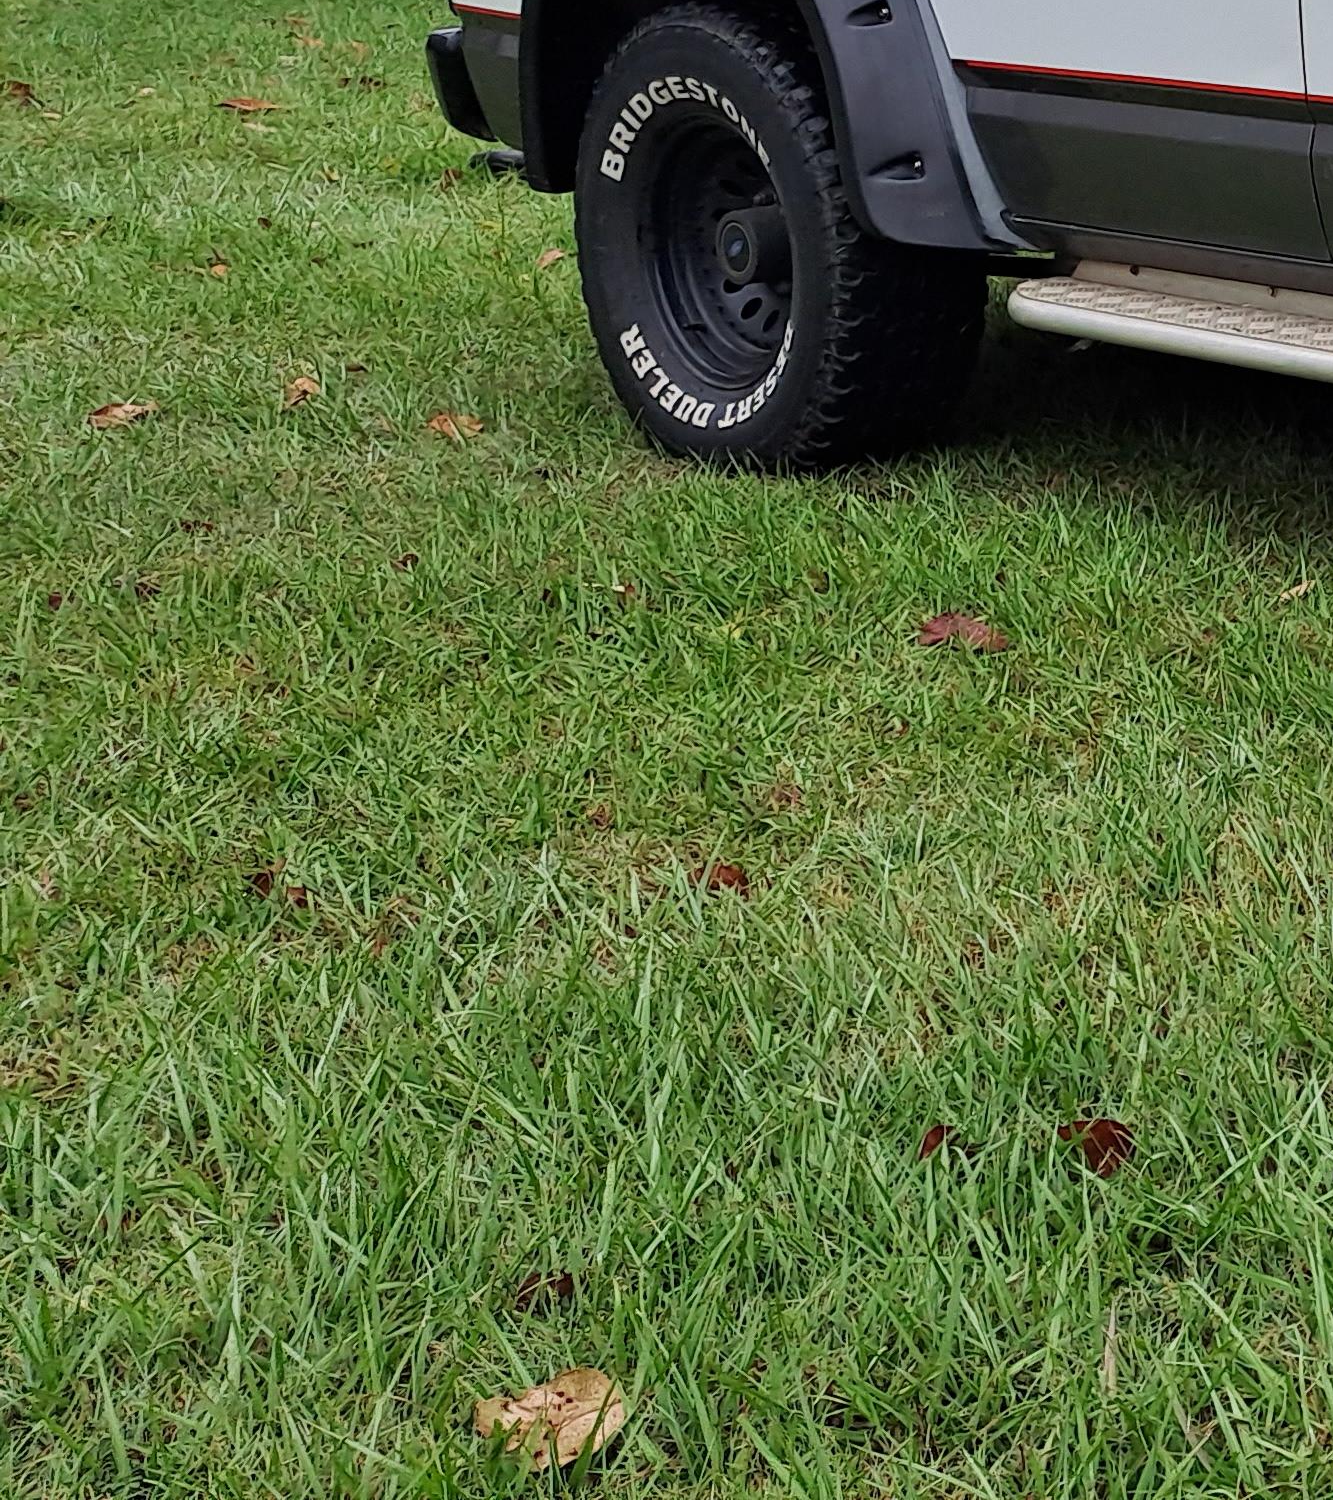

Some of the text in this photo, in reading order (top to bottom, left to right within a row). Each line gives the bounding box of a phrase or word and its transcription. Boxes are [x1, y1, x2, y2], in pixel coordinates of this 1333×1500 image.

[601, 77, 770, 182] BRIDGESTONE
[619, 320, 794, 429] DESERT DUELER
